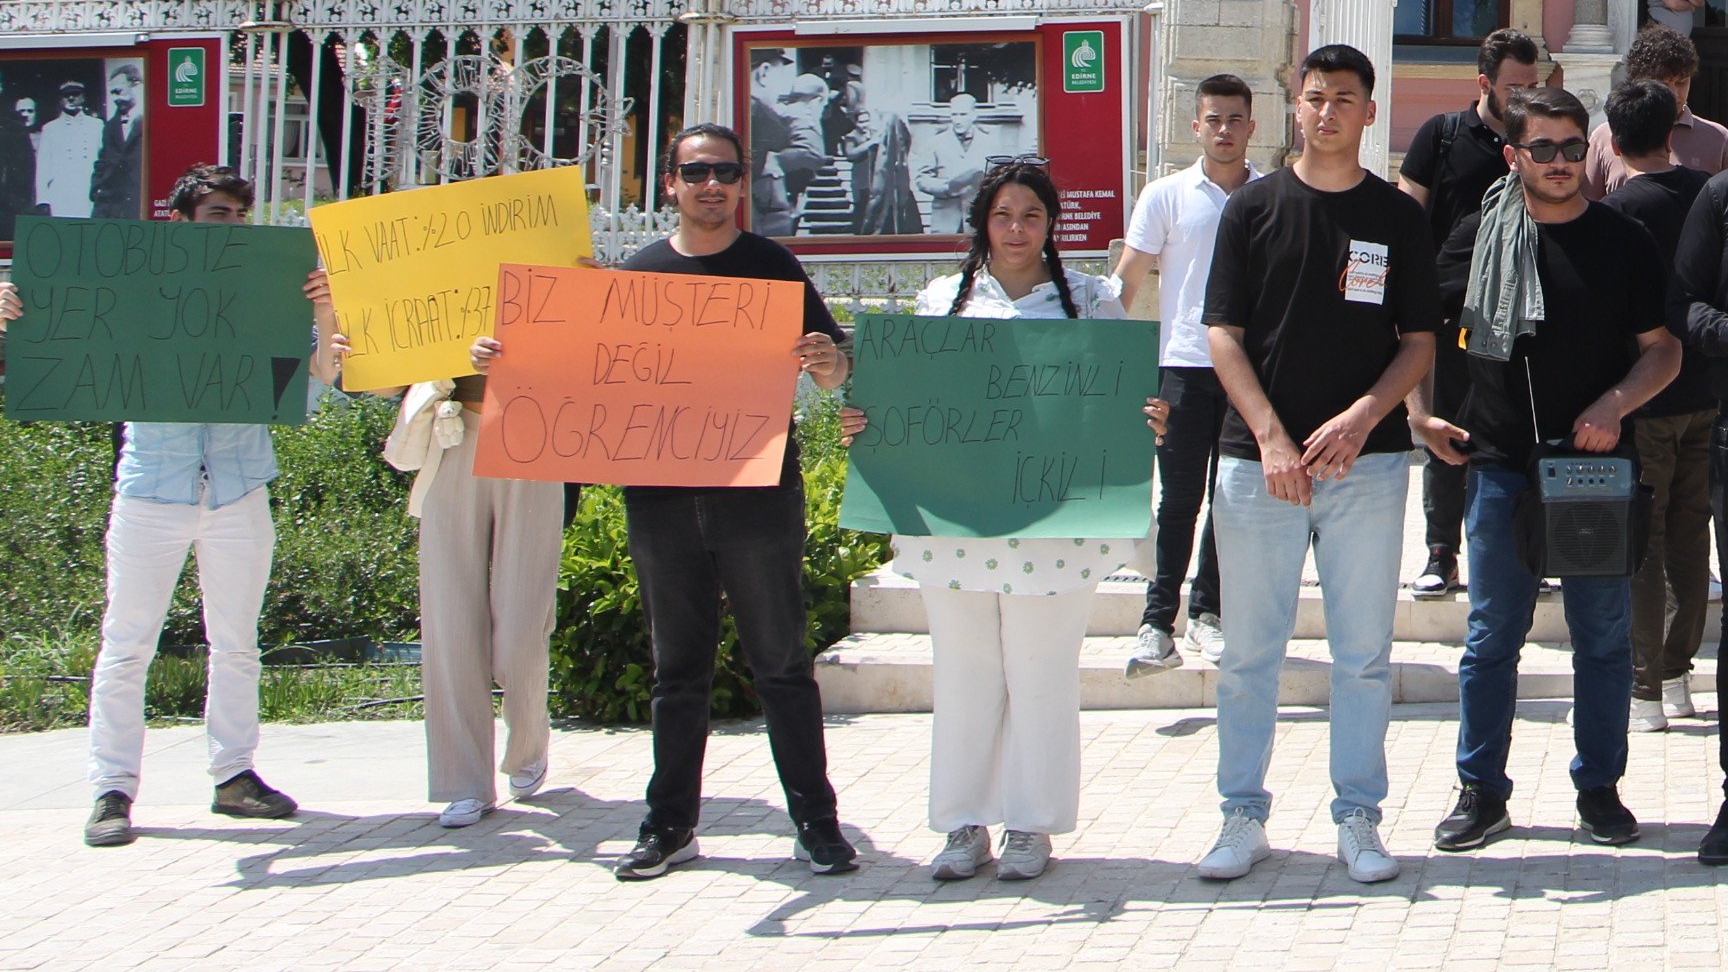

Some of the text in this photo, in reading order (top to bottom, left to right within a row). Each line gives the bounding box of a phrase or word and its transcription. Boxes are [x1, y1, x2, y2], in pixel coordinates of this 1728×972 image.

[1066, 190, 1094, 198] MUSTAFA
[1094, 189, 1116, 198] KEMAL
[1074, 210, 1101, 220] BELEDİYE
[26, 221, 253, 279] OTOBÜSTE
[316, 230, 363, 276] İLK
[480, 194, 558, 236] İNDİRİM
[25, 285, 238, 344] YER YOK
[501, 268, 772, 333] BİZ MÜŞTERİ
[593, 341, 692, 386] DEĞİL
[857, 319, 997, 363] ARAÇLAR
[15, 353, 147, 412] ZAM
[986, 361, 1124, 400] BENZİNLİ
[501, 385, 770, 464] ÖĞRENCİYİZ
[863, 398, 1023, 454] ŞOFÖRLER
[1012, 449, 1107, 509] İÇKİLİ
